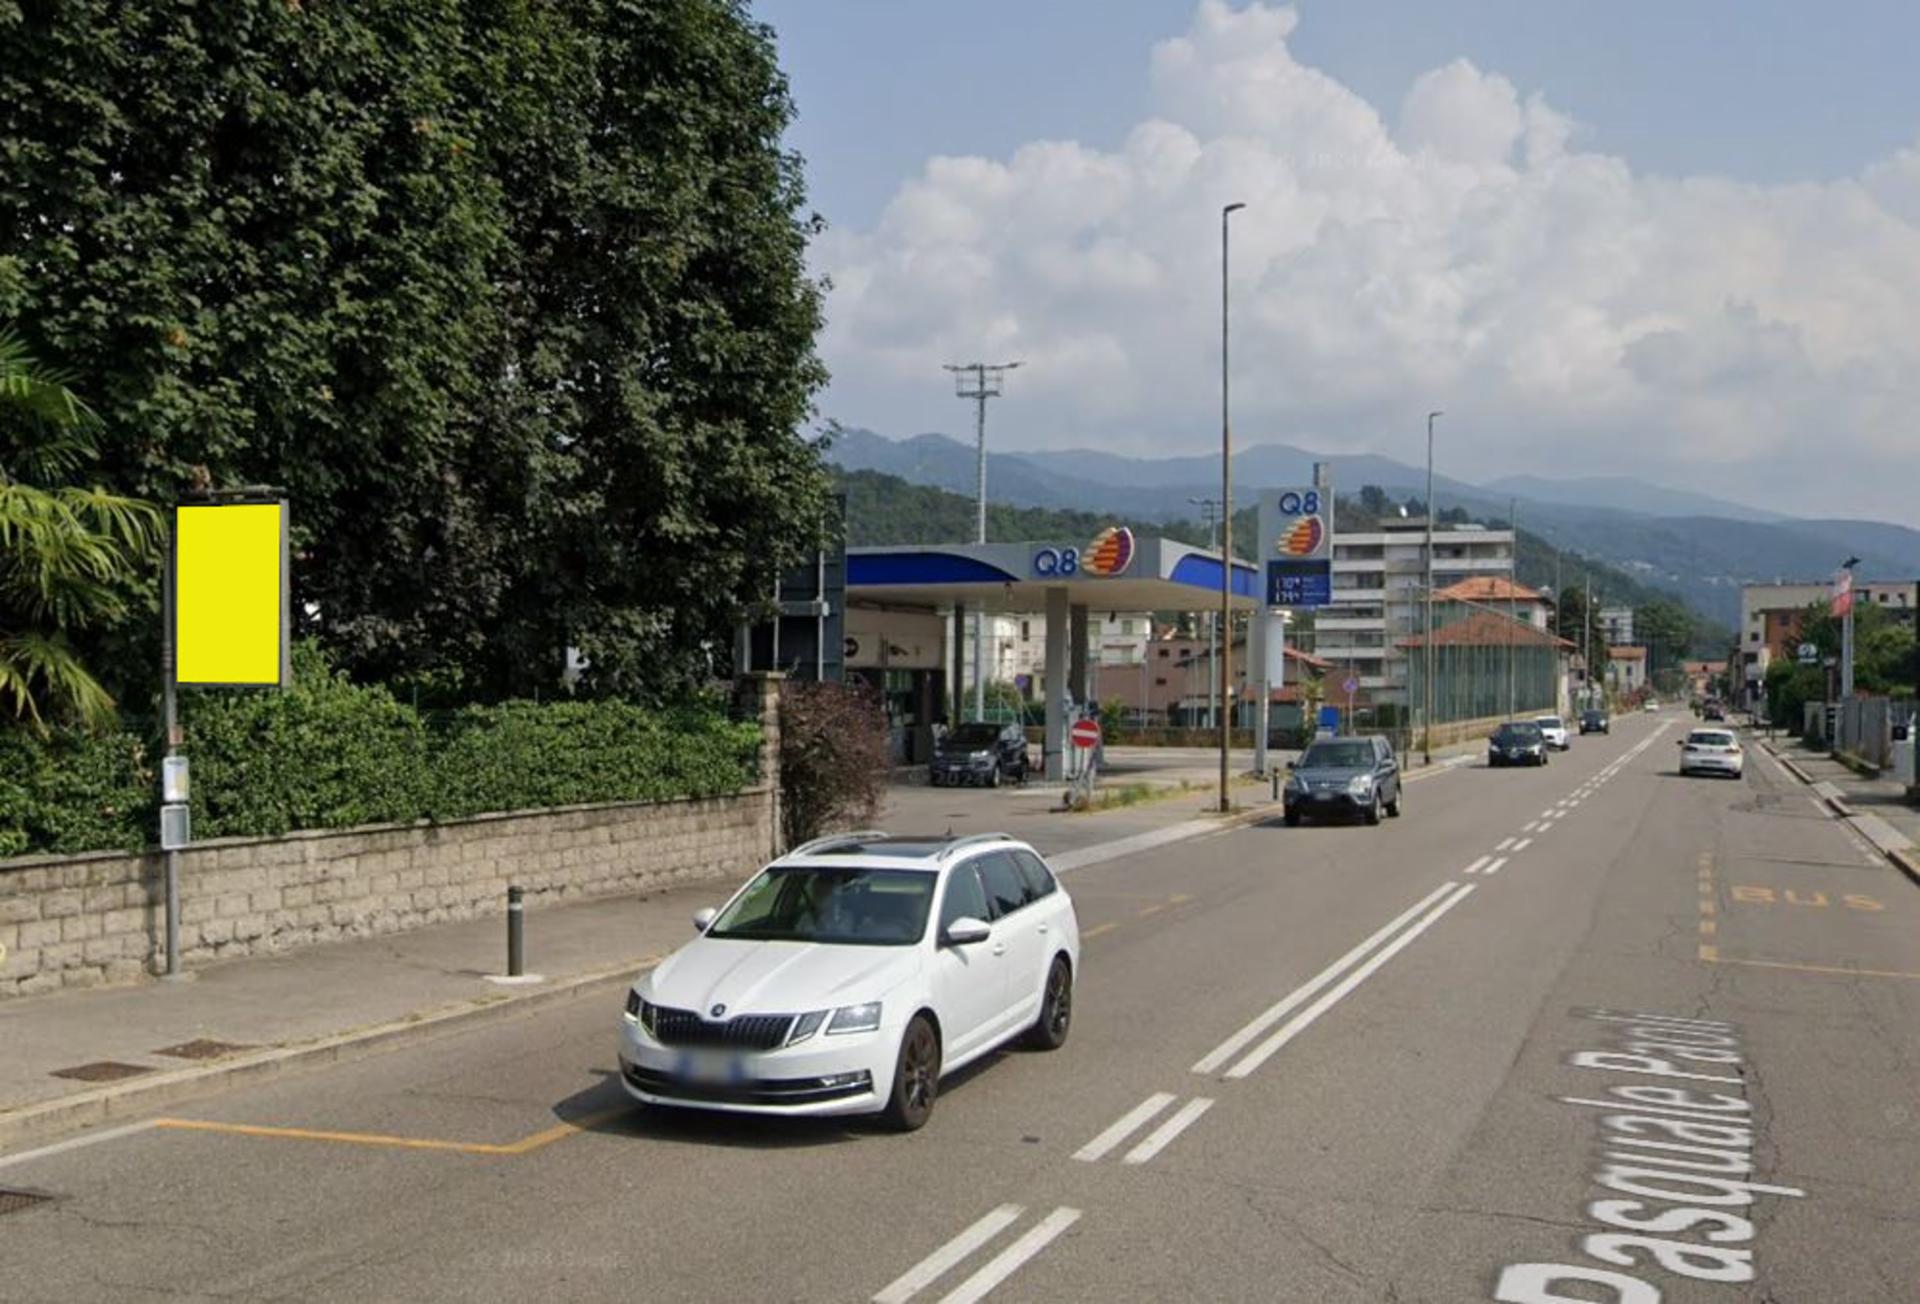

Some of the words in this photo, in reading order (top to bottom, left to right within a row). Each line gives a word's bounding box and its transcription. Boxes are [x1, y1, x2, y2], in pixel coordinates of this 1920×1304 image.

[1280, 491, 1318, 515] Q8
[1034, 549, 1078, 577] Q8
[1730, 885, 1885, 912] BUS
